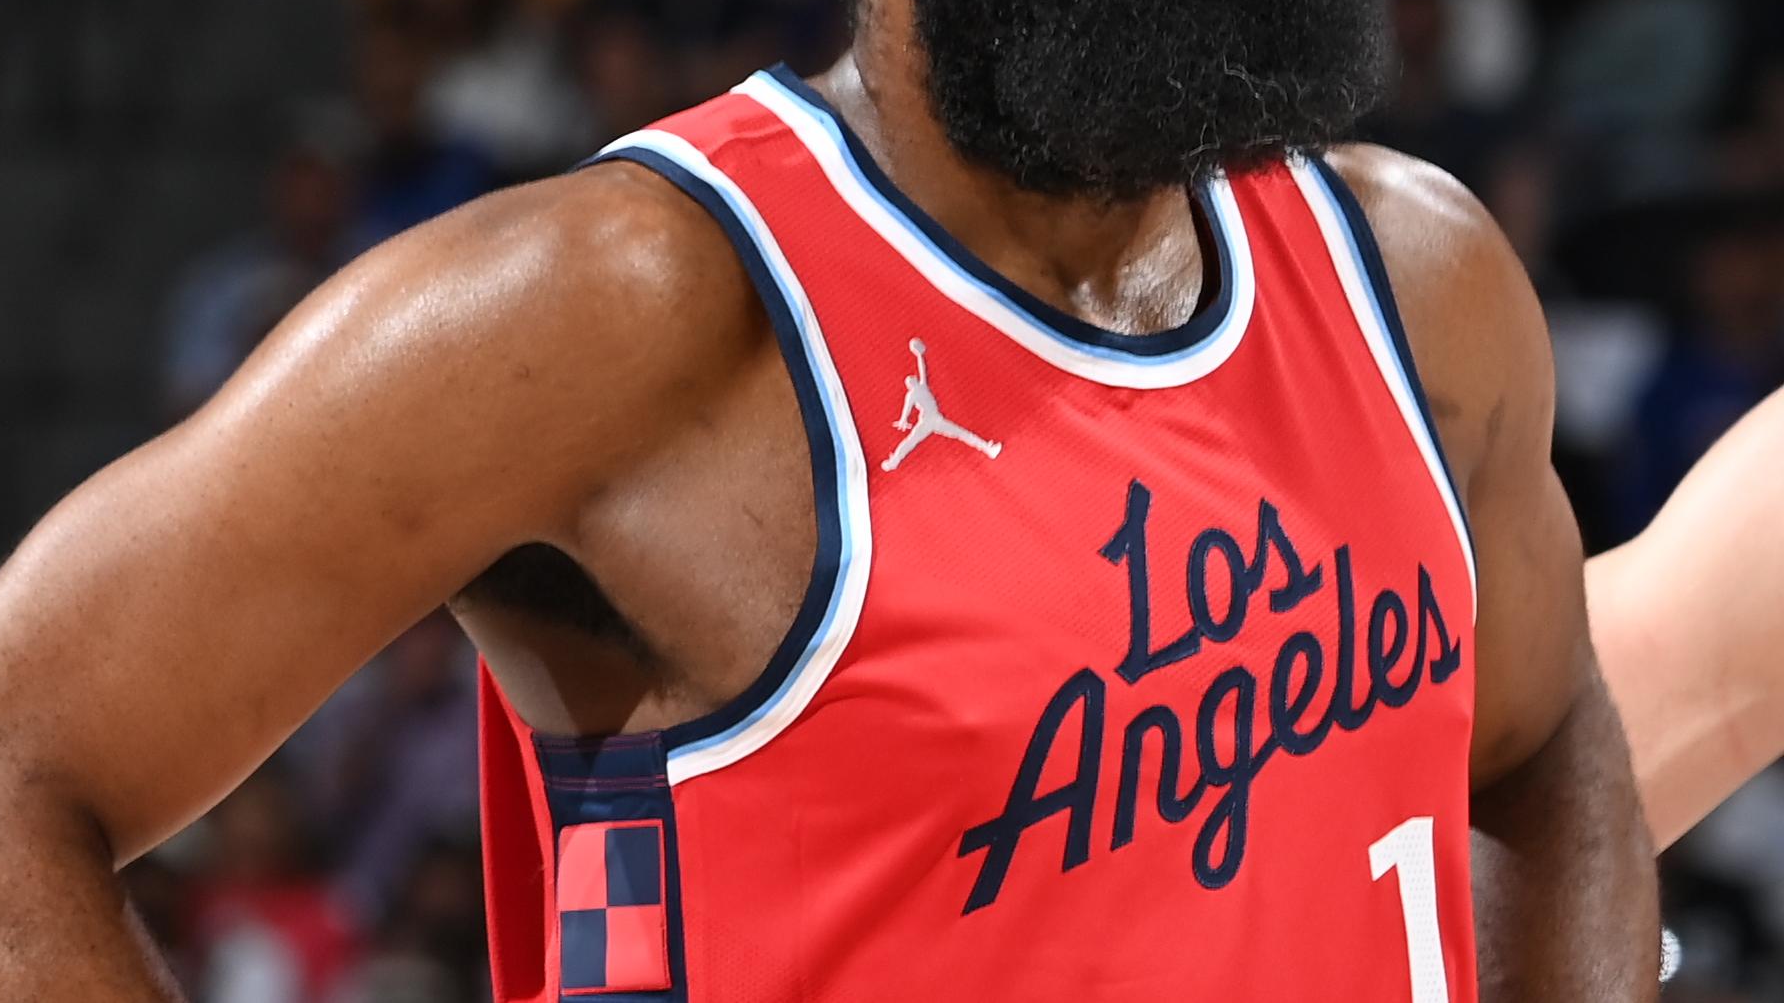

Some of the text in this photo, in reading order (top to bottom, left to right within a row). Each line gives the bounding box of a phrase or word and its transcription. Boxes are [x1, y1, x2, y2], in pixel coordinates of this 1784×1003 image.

[1098, 478, 1323, 685] Los
[957, 544, 1461, 917] Angeles
[1368, 816, 1449, 1003] 1
